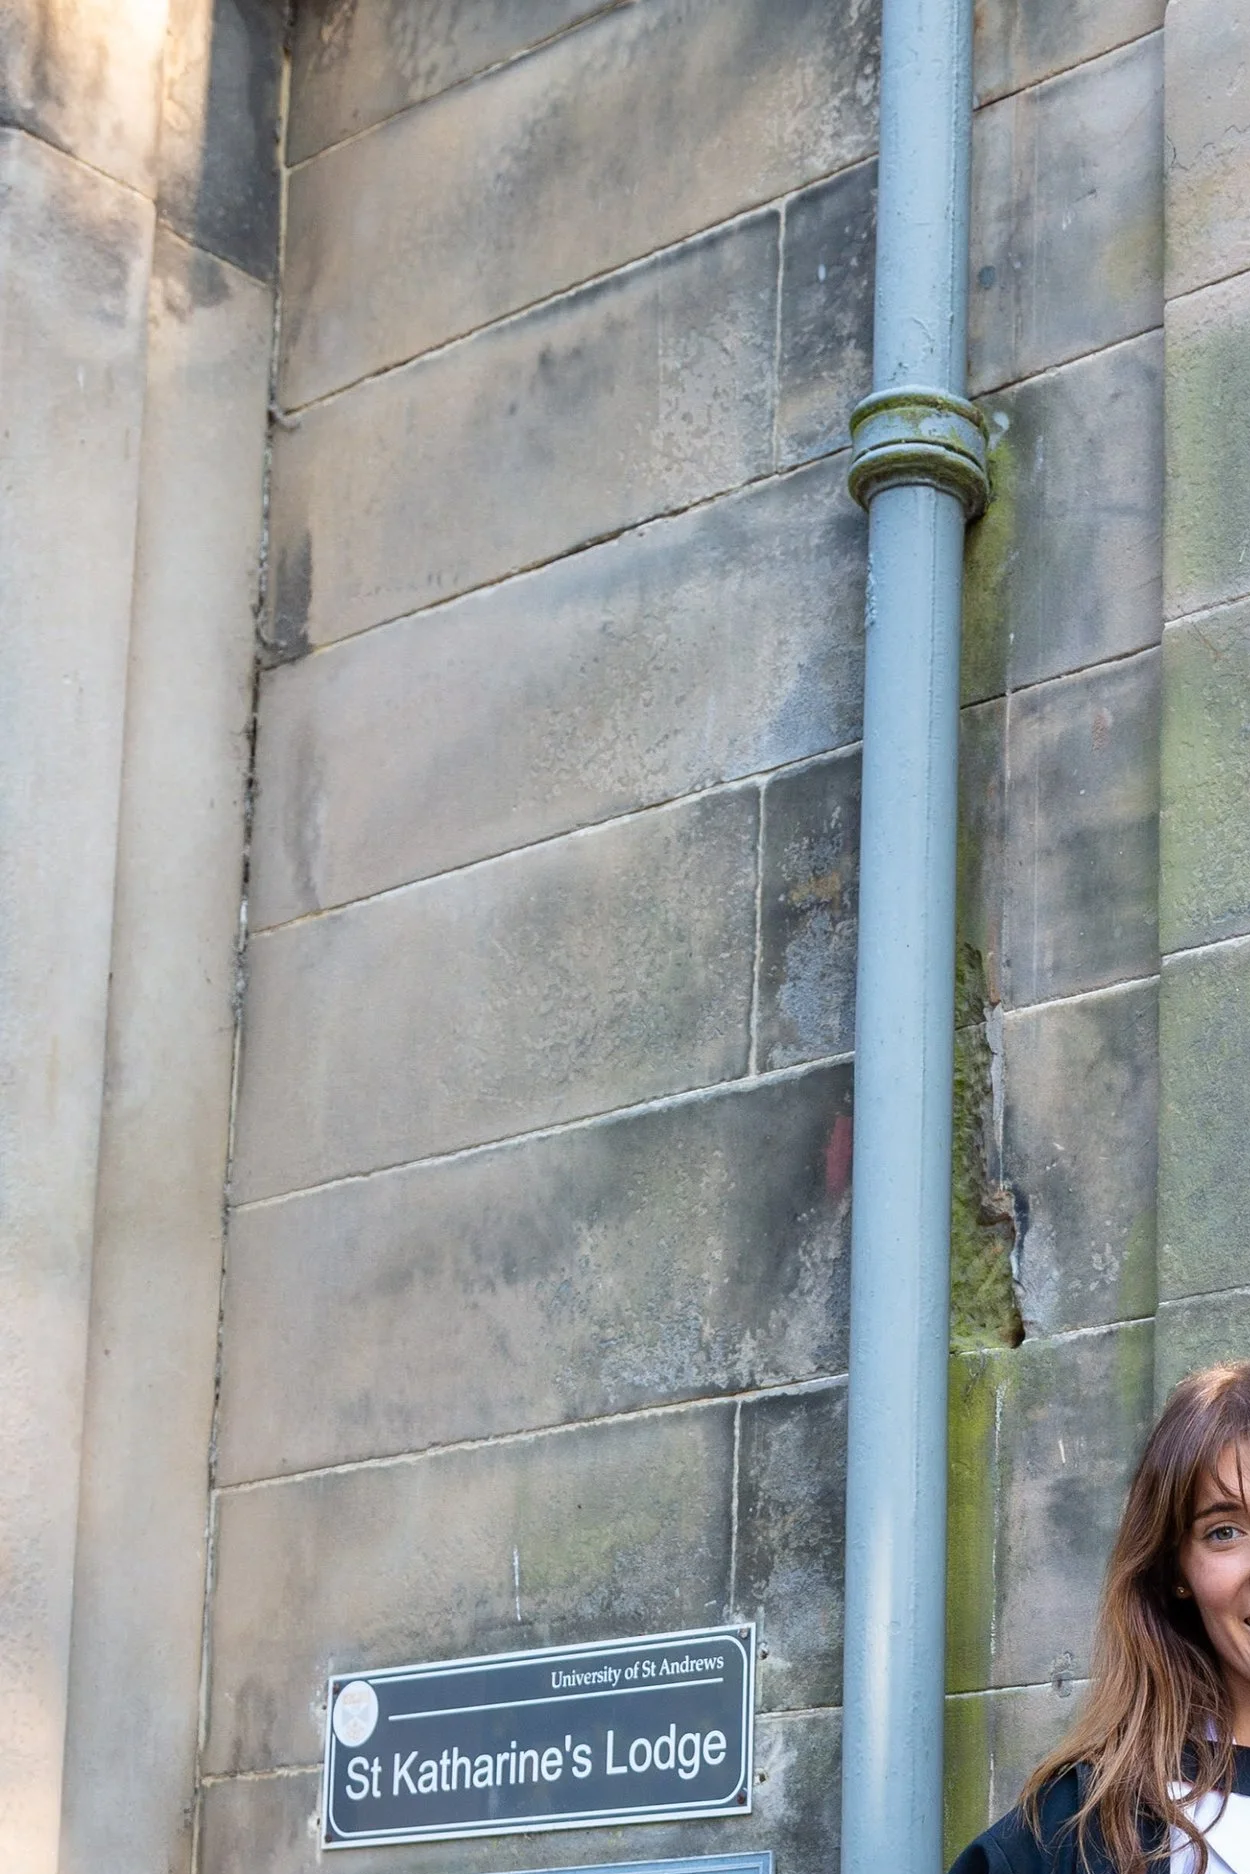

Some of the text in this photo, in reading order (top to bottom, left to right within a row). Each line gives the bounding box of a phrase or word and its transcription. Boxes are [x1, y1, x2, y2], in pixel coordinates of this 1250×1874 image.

[551, 1655, 724, 1689] University of St Andrews
[345, 1723, 727, 1801] St Katharine's Lodge
